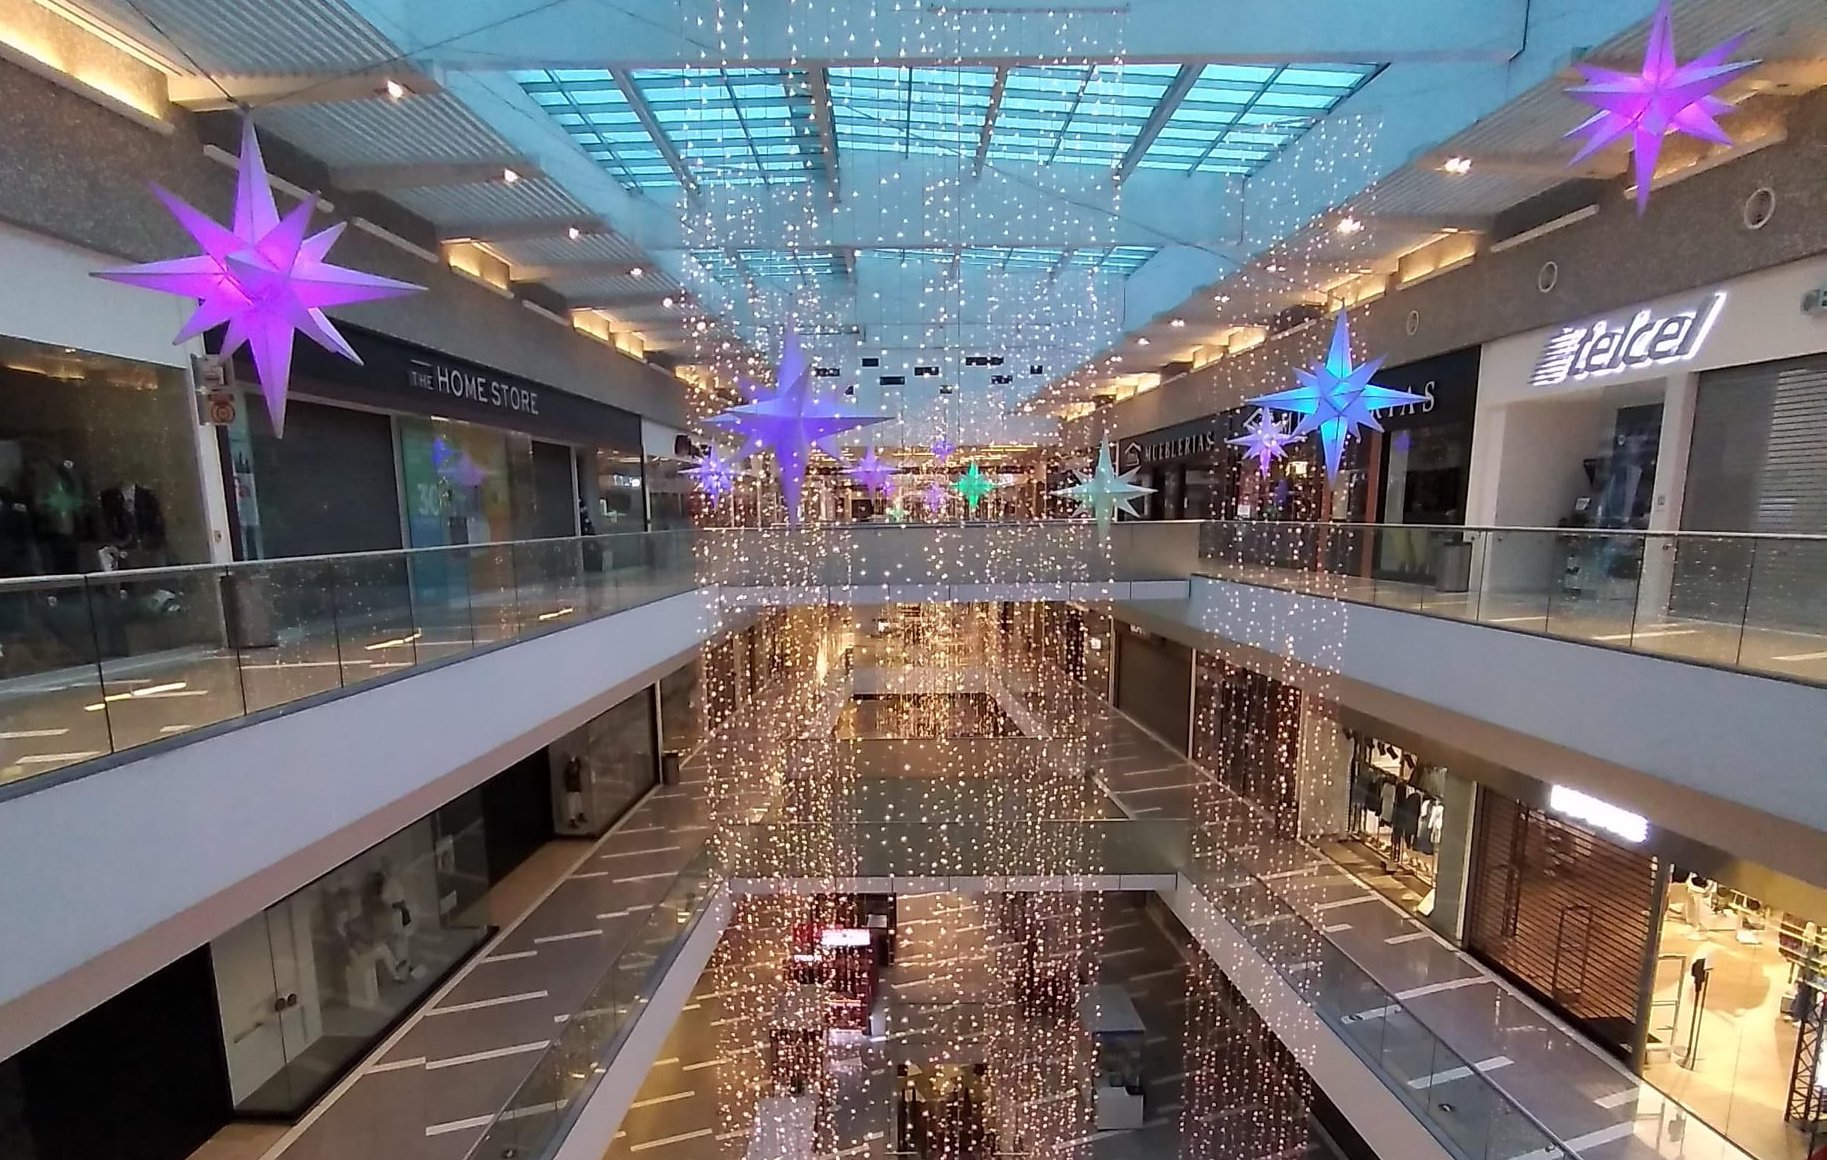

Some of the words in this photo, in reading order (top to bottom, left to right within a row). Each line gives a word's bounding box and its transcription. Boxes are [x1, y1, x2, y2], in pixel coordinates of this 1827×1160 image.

[411, 370, 434, 391] THE
[437, 365, 488, 403] HOME
[491, 381, 540, 415] STORE
